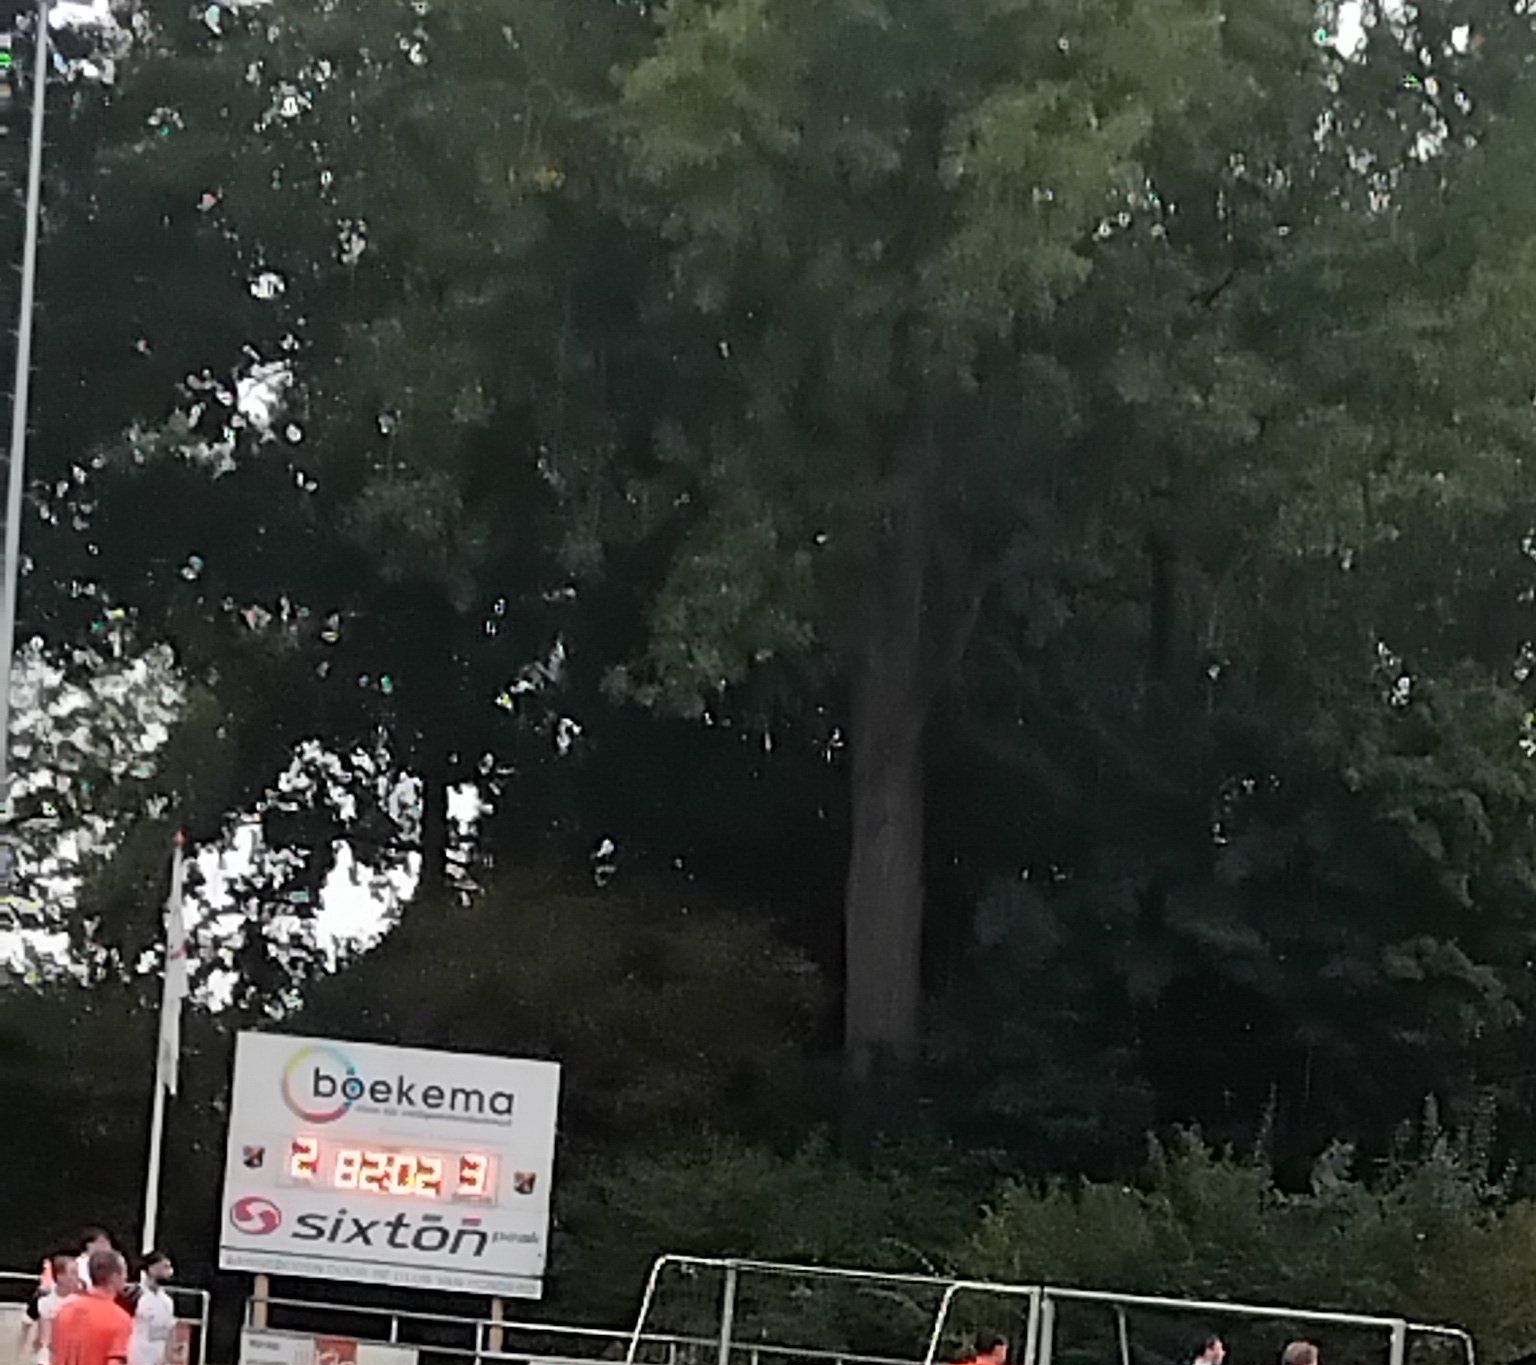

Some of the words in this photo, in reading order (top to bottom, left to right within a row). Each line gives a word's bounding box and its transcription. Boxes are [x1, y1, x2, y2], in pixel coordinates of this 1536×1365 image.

[313, 1066, 515, 1116] boekema
[291, 1137, 317, 1179] 2
[458, 1153, 487, 1195] 3
